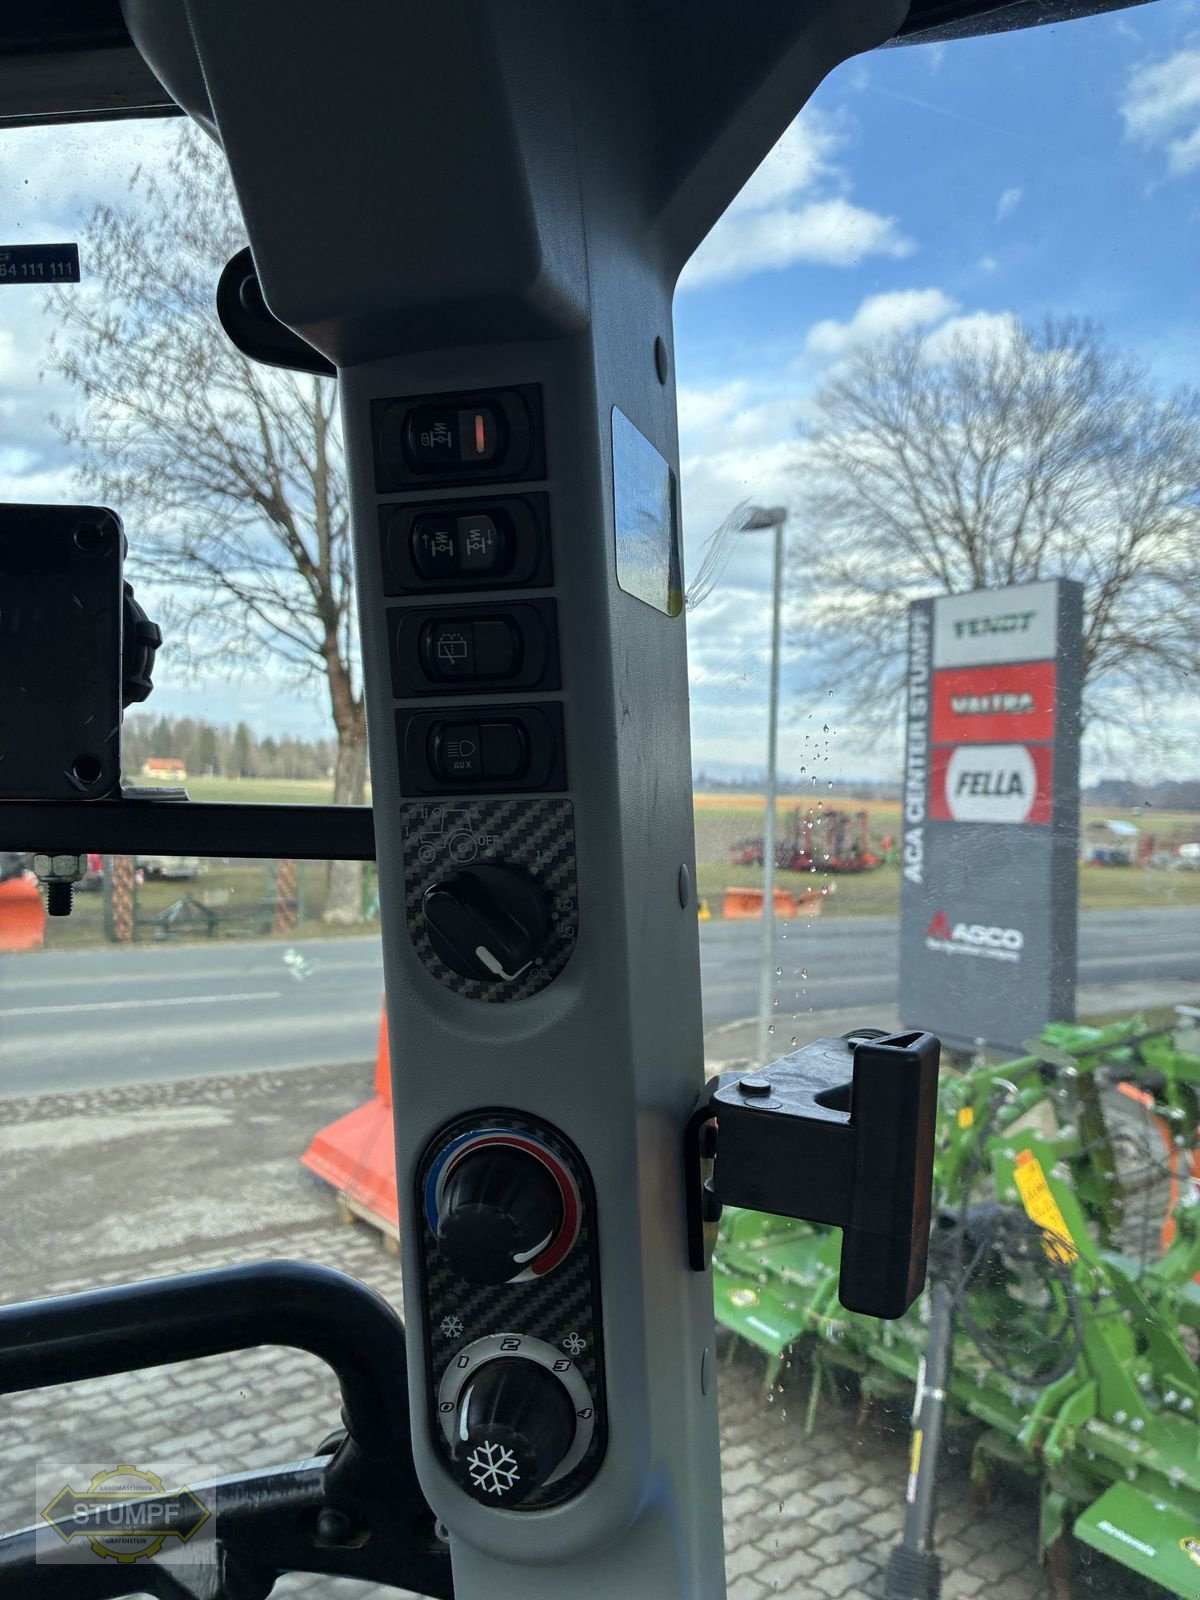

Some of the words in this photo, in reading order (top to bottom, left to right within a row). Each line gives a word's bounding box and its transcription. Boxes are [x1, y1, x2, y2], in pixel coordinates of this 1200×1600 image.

[21, 263, 44, 276] 111
[50, 261, 72, 275] 111
[954, 610, 1036, 638] FENDT
[453, 760, 472, 769] AUX
[905, 720, 928, 824] CENTER
[956, 771, 1024, 796] FELLA
[478, 835, 499, 846] OFF
[501, 1338, 520, 1351] 2
[457, 1355, 469, 1368] 1
[552, 1359, 571, 1372] 3
[439, 1401, 454, 1413] 0
[577, 1407, 593, 1419] 4
